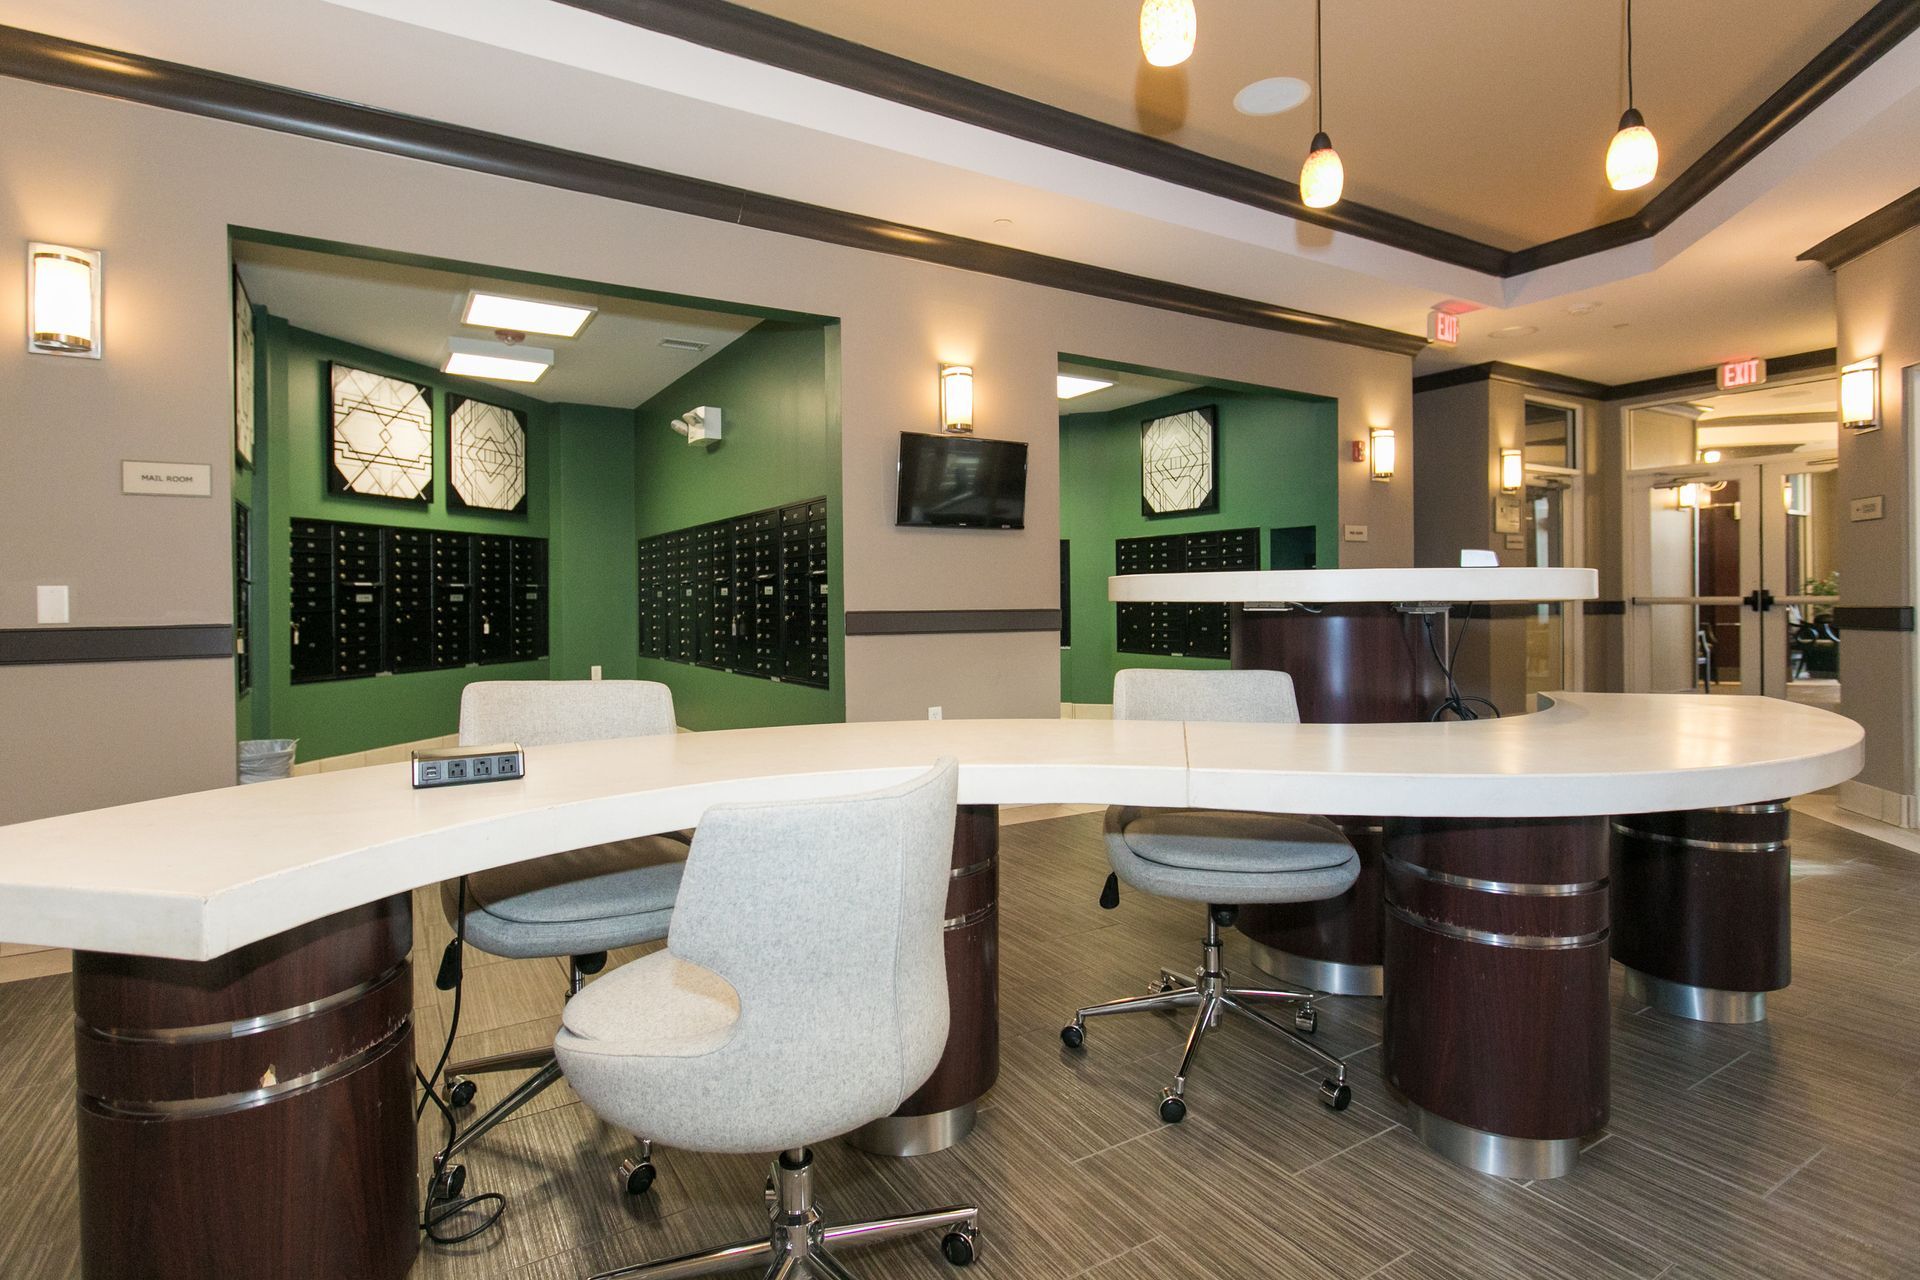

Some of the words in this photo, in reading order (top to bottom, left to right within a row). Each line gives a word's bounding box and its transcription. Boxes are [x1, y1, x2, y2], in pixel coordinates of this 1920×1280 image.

[1437, 312, 1457, 343] EXIT
[1724, 360, 1760, 387] EXIT
[141, 474, 163, 482] MAIL
[166, 475, 193, 483] ROOM
